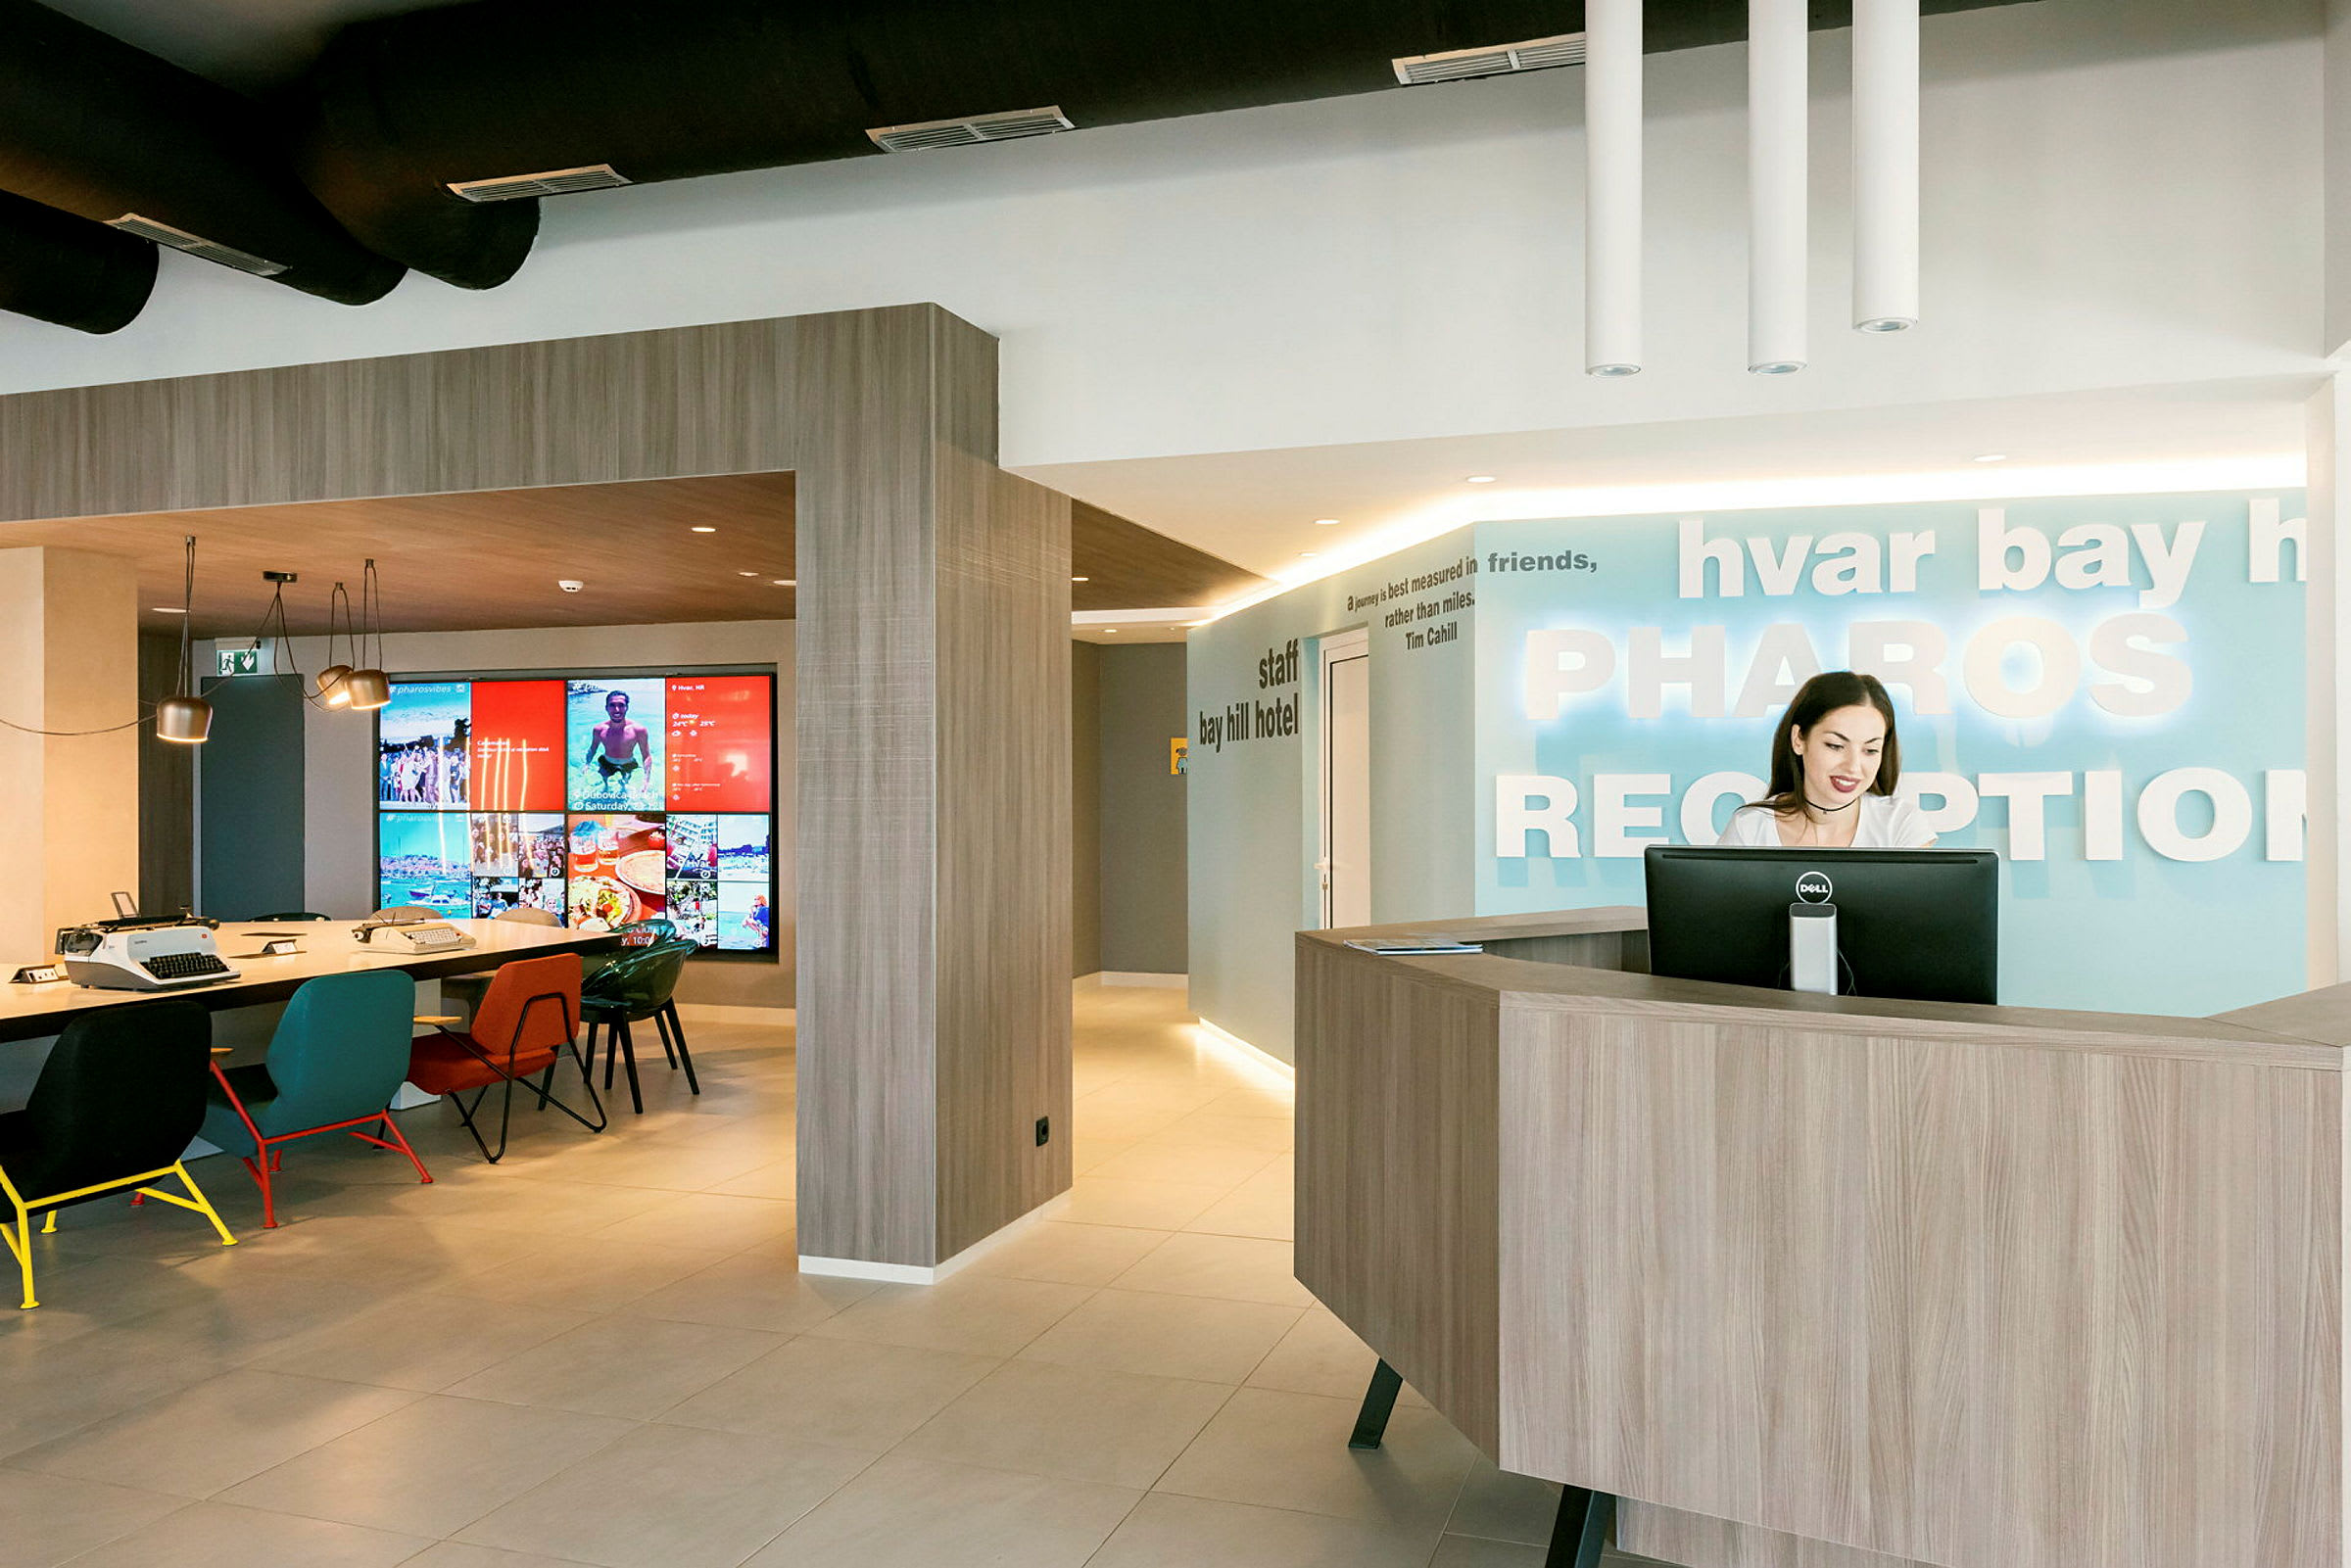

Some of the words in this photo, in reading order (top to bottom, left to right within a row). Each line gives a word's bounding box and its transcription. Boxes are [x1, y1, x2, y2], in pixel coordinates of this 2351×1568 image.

[1347, 594, 1354, 611] a
[1354, 593, 1379, 612] journey
[1380, 589, 1387, 601] is
[1388, 578, 1410, 599] best
[1412, 558, 1463, 594] measured
[1465, 555, 1478, 575] in
[1488, 549, 1597, 573] friends,
[1678, 518, 1936, 598] hvar
[1977, 507, 2207, 610] bay
[1384, 607, 1415, 628] rather
[1416, 601, 1440, 621] than
[1442, 591, 1475, 614] miles.
[1405, 632, 1424, 650] Tim
[1427, 621, 1458, 646] Cahill
[1259, 638, 1298, 689] staff
[1525, 612, 2194, 720] PHAROS
[1199, 710, 1223, 753] bay
[1226, 701, 1250, 742] hill
[1255, 692, 1299, 739] hotel
[1495, 767, 2308, 863] RECPTIO
[1799, 883, 1829, 893] DELL
